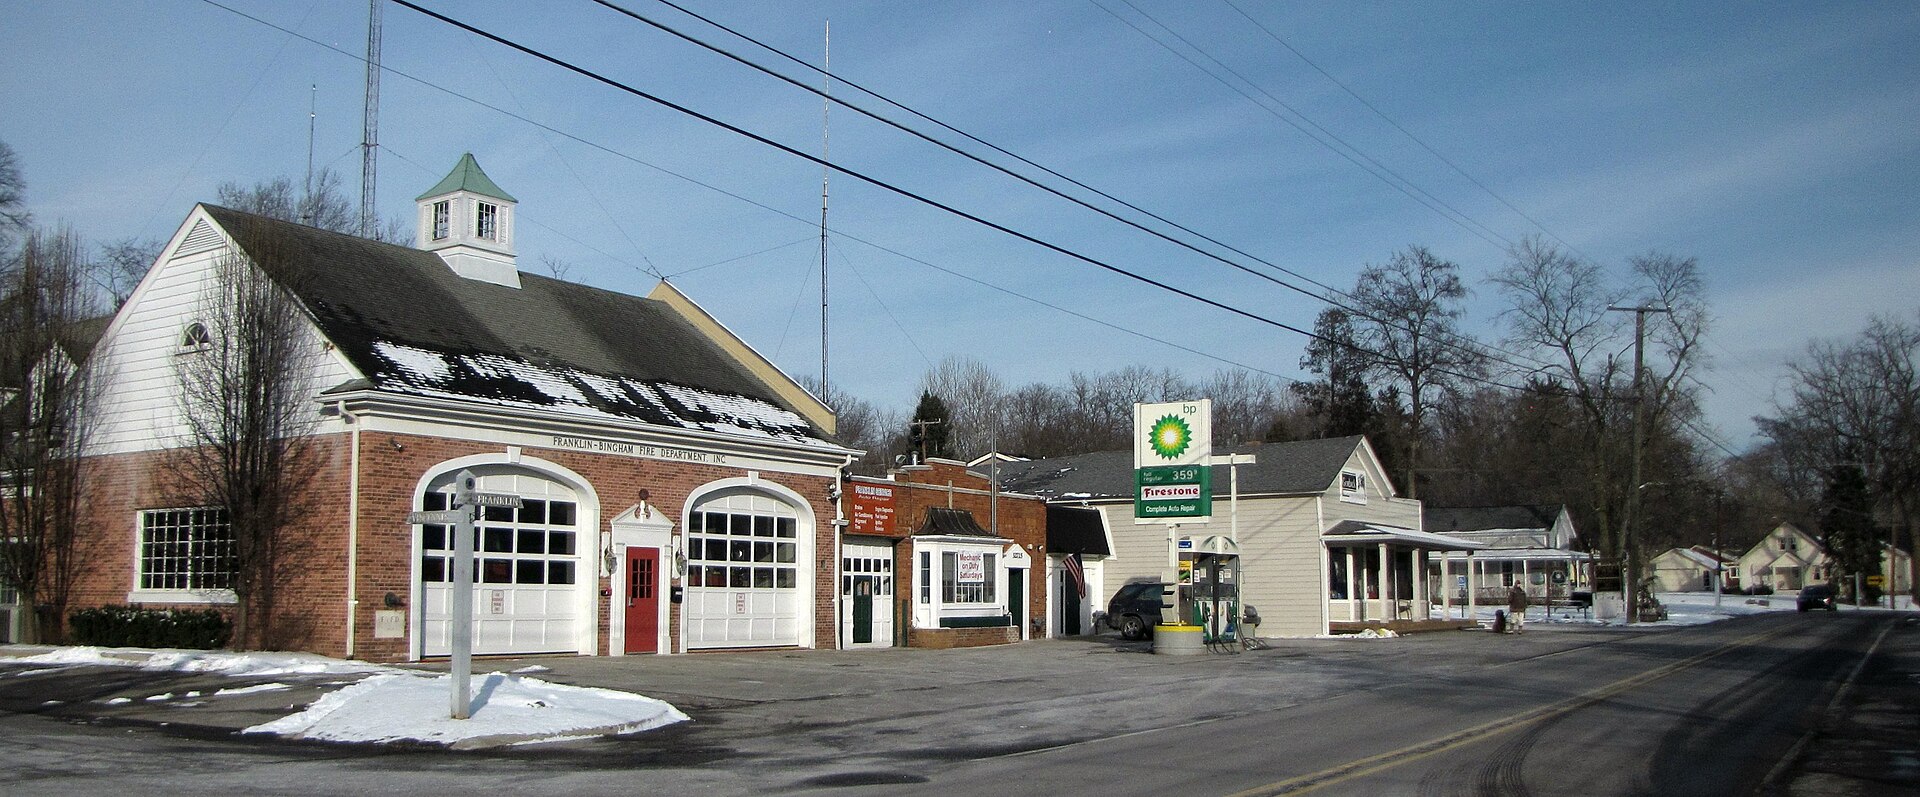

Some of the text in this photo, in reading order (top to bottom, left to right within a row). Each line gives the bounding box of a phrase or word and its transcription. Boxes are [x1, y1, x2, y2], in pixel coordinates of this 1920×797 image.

[1183, 404, 1197, 415] bp
[553, 436, 634, 454] FRANKLIN-BINGHAM
[640, 445, 655, 456] FIRE
[1144, 487, 1198, 498] Firestone
[477, 495, 519, 506] FRANKLIN
[1146, 505, 1167, 514] Complete
[1180, 504, 1195, 513] Repair
[960, 553, 981, 561] Mechanic
[969, 562, 979, 571] Duty
[960, 571, 983, 579] Saturdays
